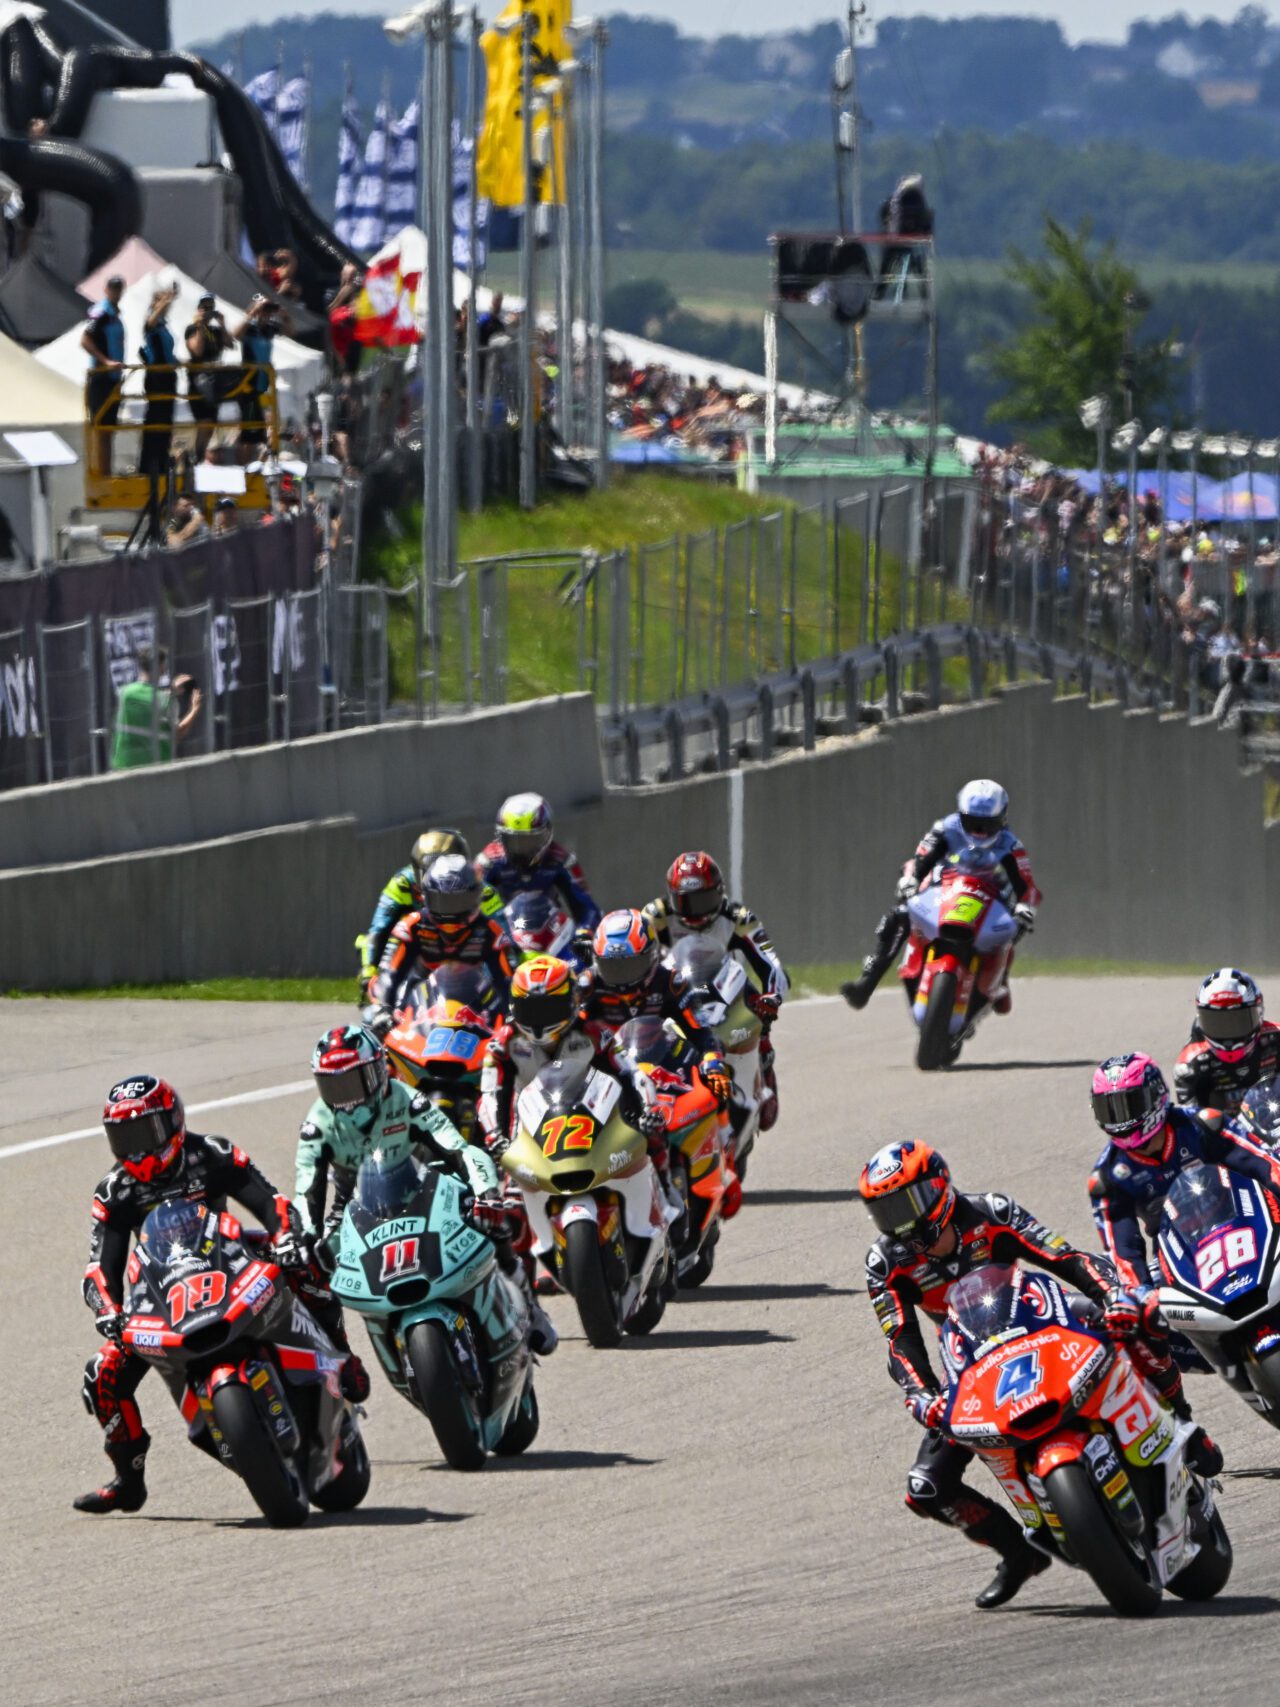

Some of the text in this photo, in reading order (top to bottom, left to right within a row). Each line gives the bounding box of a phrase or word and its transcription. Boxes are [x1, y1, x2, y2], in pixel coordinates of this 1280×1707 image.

[422, 1027, 479, 1059] 98
[542, 1114, 595, 1159] 72
[372, 1220, 417, 1244] KLINT
[380, 1238, 420, 1282] 11
[1195, 1227, 1257, 1292] 28
[166, 1270, 227, 1328] 18
[340, 1277, 362, 1290] YOB
[135, 1334, 161, 1346] LIQUI
[976, 1333, 1061, 1378] audio-technica
[995, 1349, 1043, 1411] 4
[1009, 1392, 1047, 1421] ALIUM
